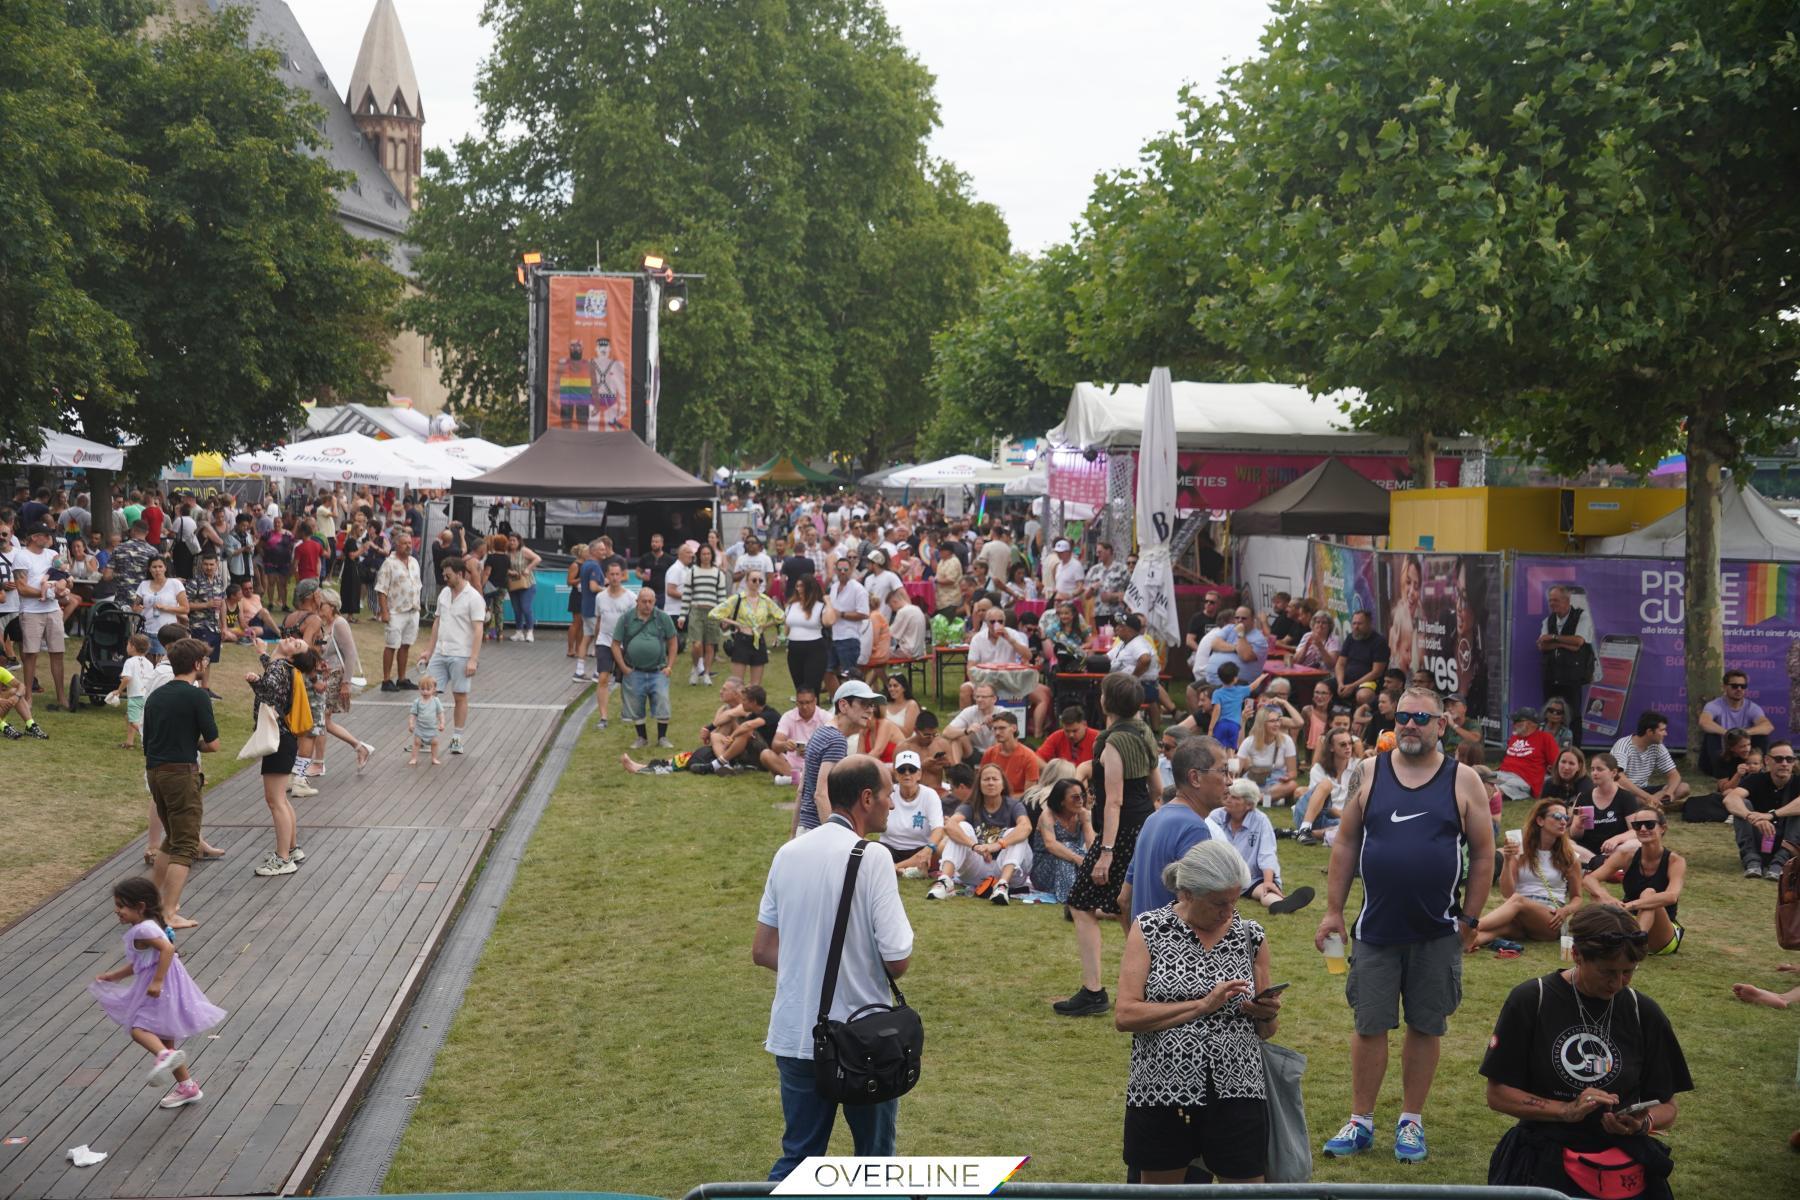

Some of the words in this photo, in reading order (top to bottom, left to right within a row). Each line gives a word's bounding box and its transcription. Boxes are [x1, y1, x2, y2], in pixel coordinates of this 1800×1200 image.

[353, 473, 379, 482] BINDING
[1641, 570, 1740, 597] PRE
[1639, 598, 1739, 626] GUE
[1641, 626, 1656, 635] alle
